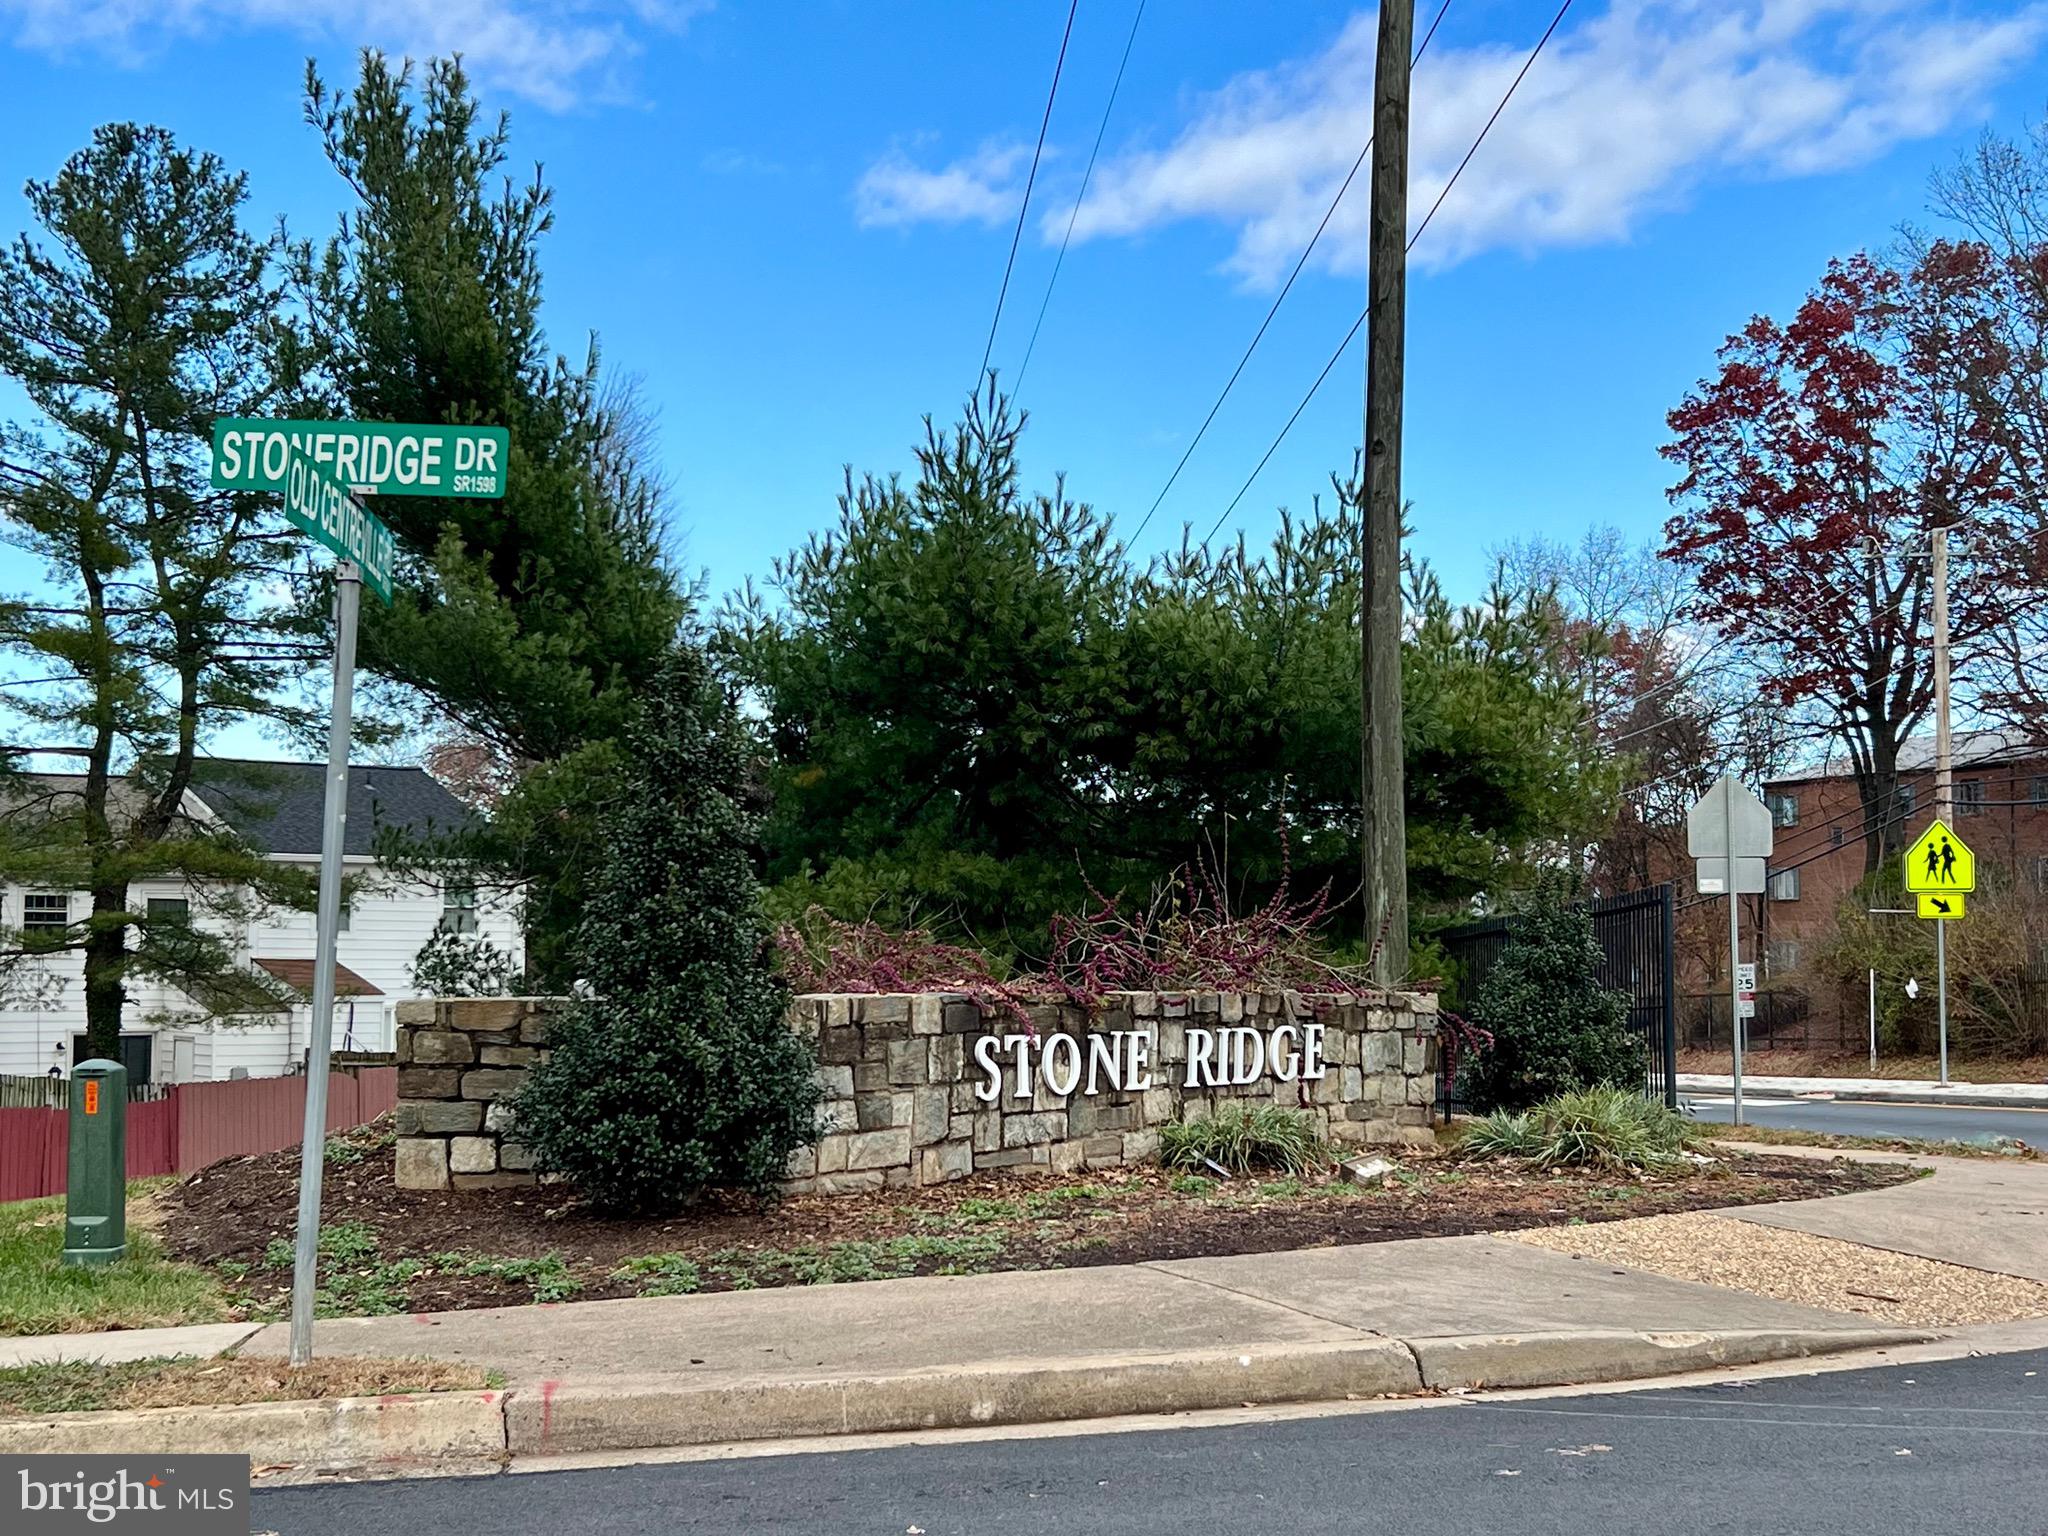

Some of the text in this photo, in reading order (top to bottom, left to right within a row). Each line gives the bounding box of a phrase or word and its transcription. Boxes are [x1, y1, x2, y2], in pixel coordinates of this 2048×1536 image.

[455, 437, 497, 472] DR
[290, 458, 319, 521] OLD
[974, 1024, 1325, 1101] STONE RIDGE
